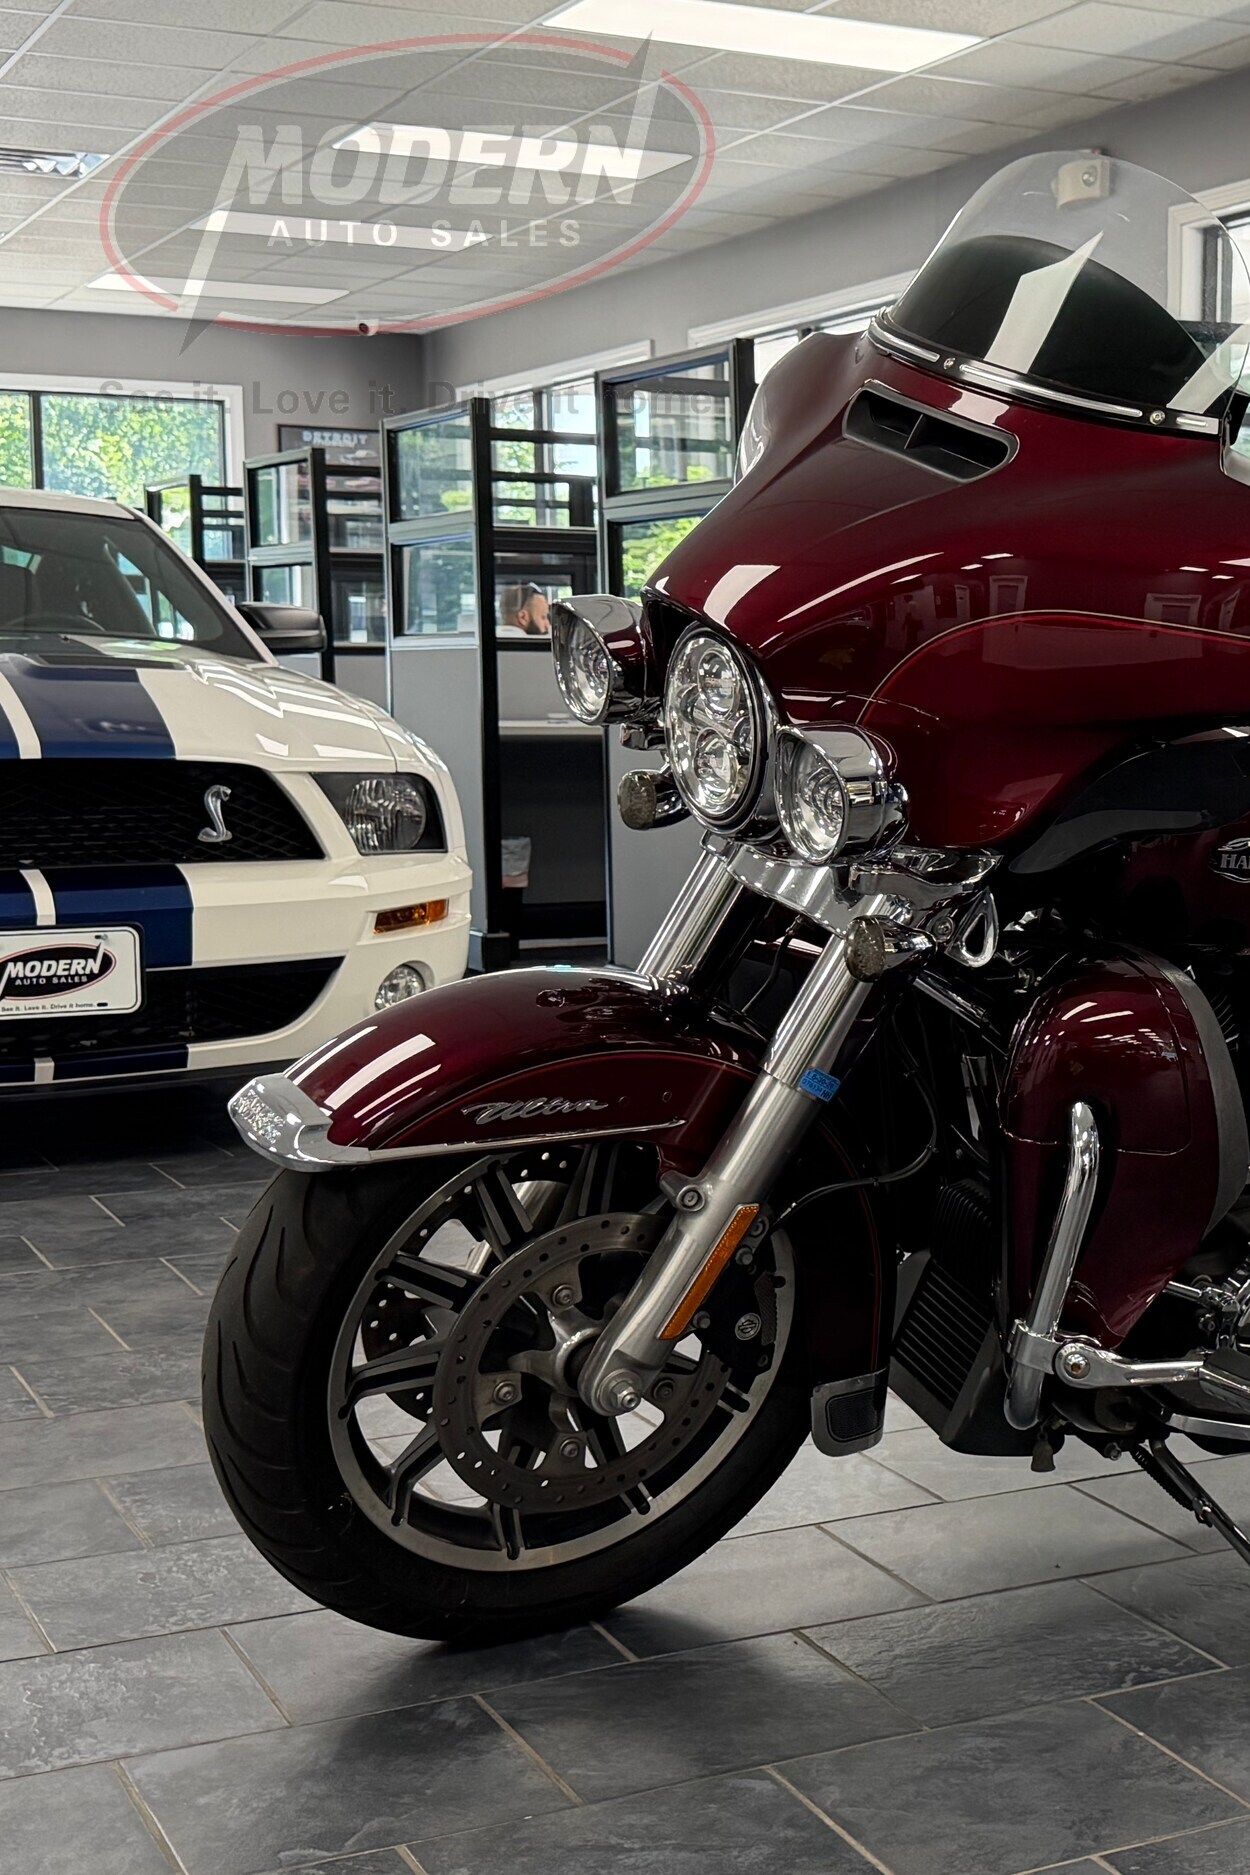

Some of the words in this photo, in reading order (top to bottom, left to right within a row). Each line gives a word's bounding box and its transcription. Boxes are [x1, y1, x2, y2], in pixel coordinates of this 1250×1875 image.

[7, 957, 102, 978] MODERN
[15, 978, 47, 986] AUTO
[51, 975, 88, 983] SALES
[460, 1097, 608, 1125] Ultra
